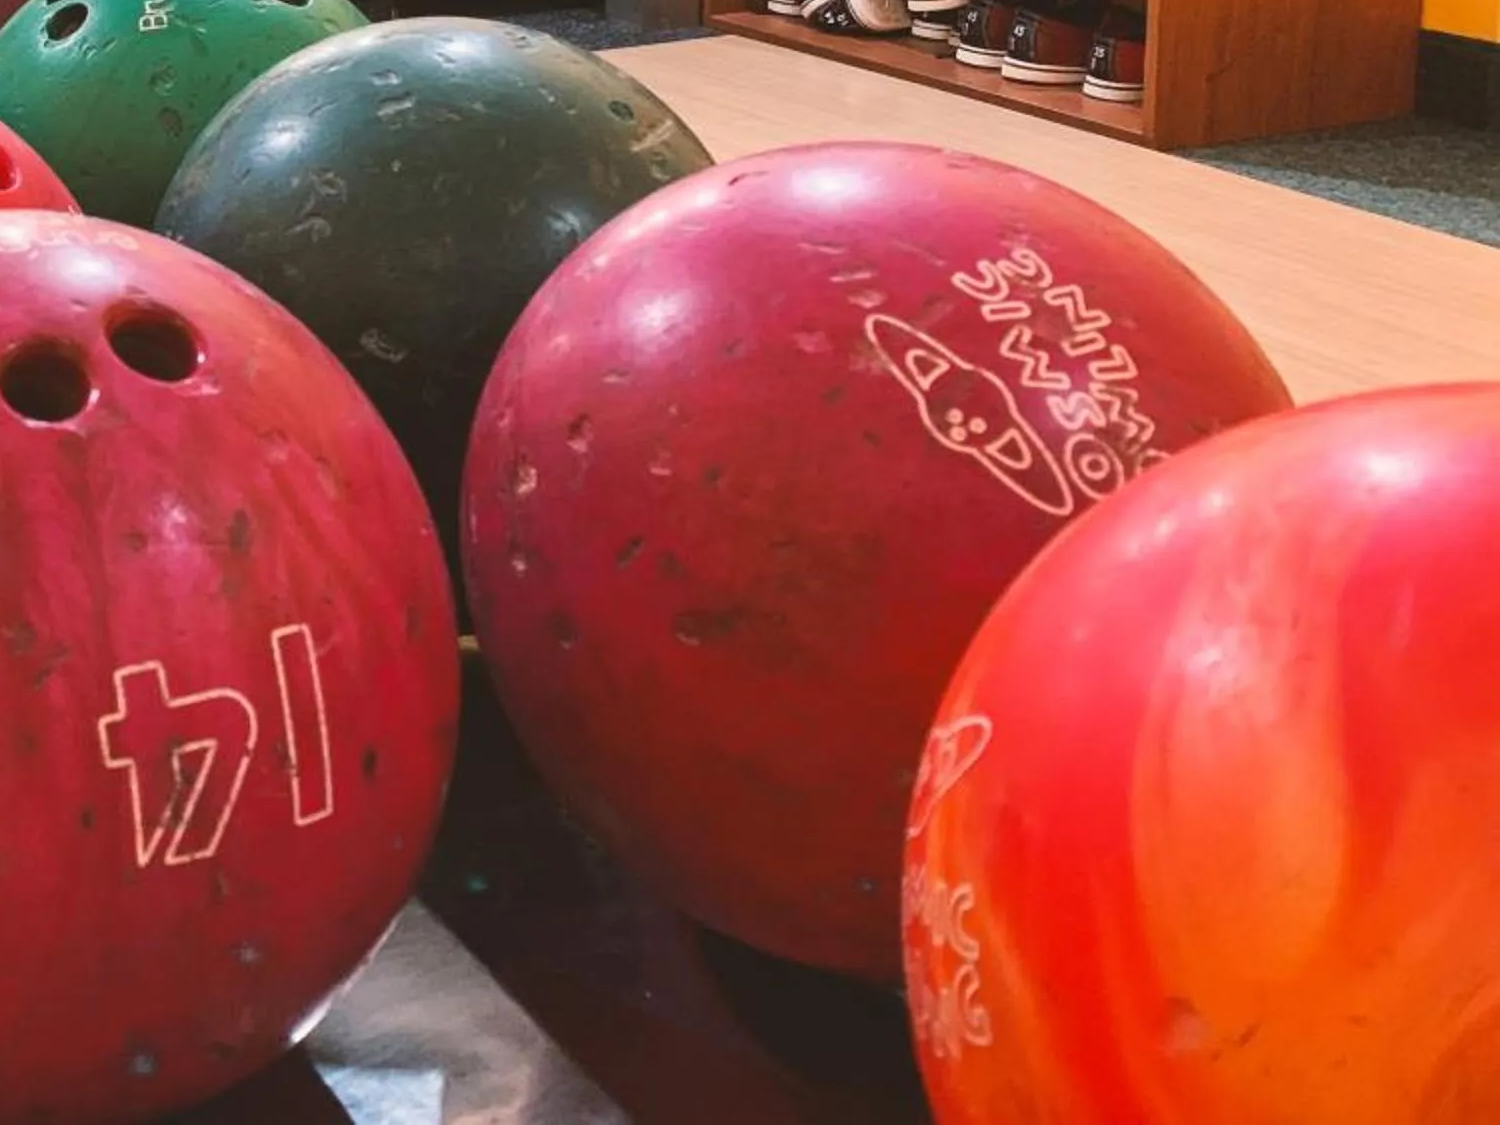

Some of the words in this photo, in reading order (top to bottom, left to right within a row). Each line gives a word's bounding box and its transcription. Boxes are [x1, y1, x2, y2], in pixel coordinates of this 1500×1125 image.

[950, 259, 1125, 500] OSMIC
[995, 247, 1172, 476] WLING
[97, 621, 335, 868] 14
